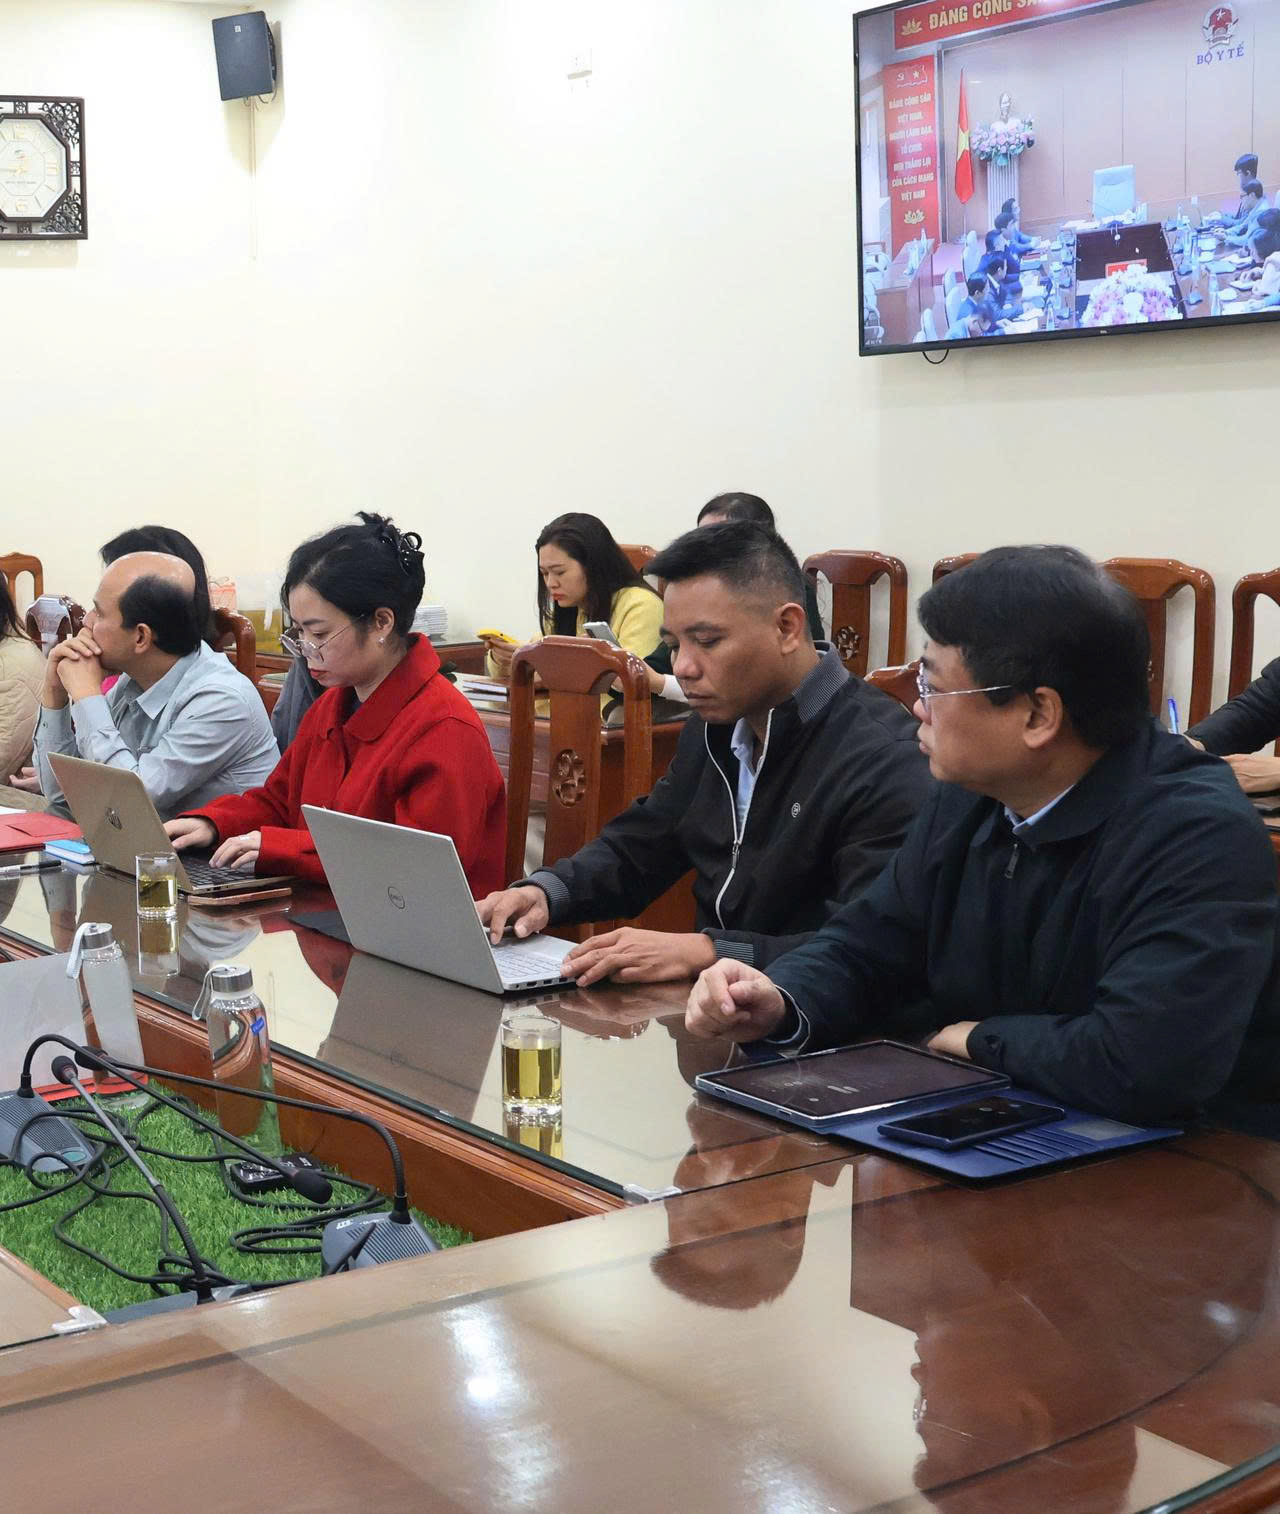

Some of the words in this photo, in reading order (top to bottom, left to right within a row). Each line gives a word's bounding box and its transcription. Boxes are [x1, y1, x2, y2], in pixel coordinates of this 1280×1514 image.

[928, 5, 969, 30] ĐẢNG
[1196, 49, 1213, 65] BỘ
[1216, 50, 1224, 61] Y
[1227, 41, 1245, 59] TẾ
